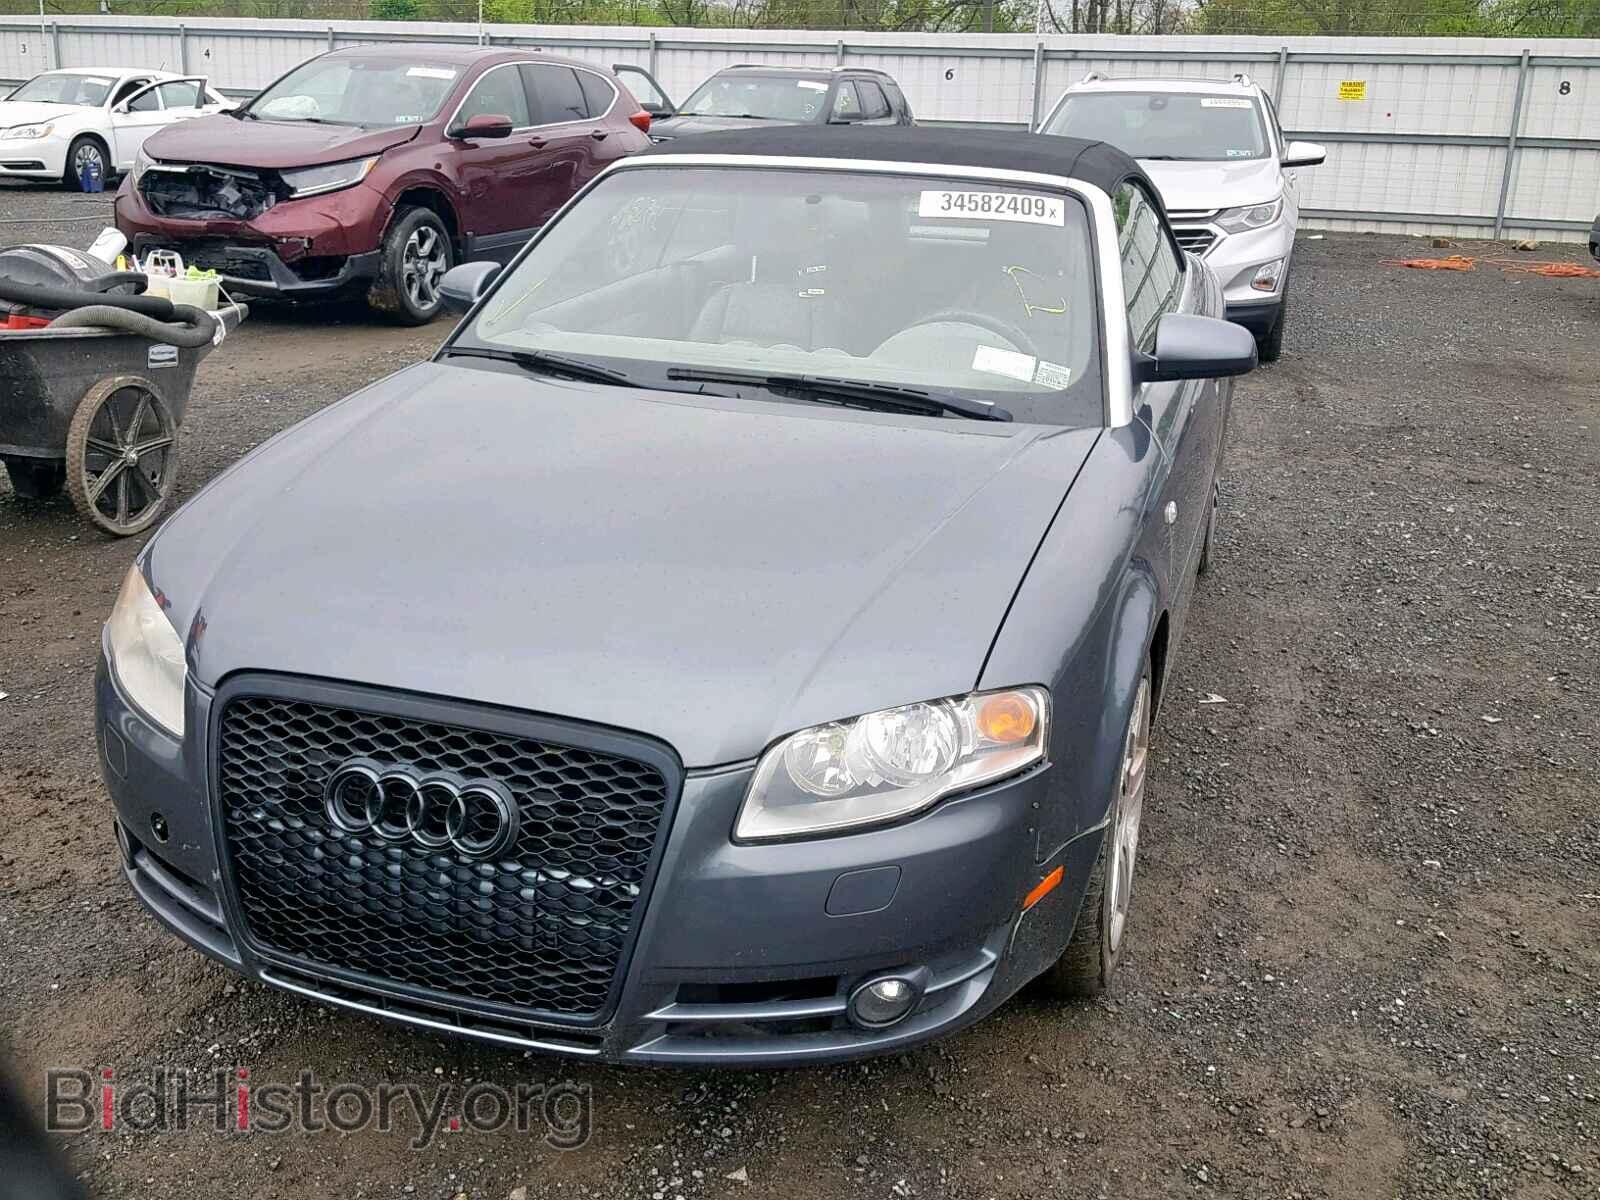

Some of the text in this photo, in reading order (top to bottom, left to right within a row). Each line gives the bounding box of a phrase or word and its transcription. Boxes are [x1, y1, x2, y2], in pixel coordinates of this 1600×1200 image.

[20, 43, 26, 54] 3
[204, 48, 211, 60] 4
[945, 68, 955, 80] 6
[1559, 80, 1571, 95] 8
[940, 192, 1046, 217] 34582409
